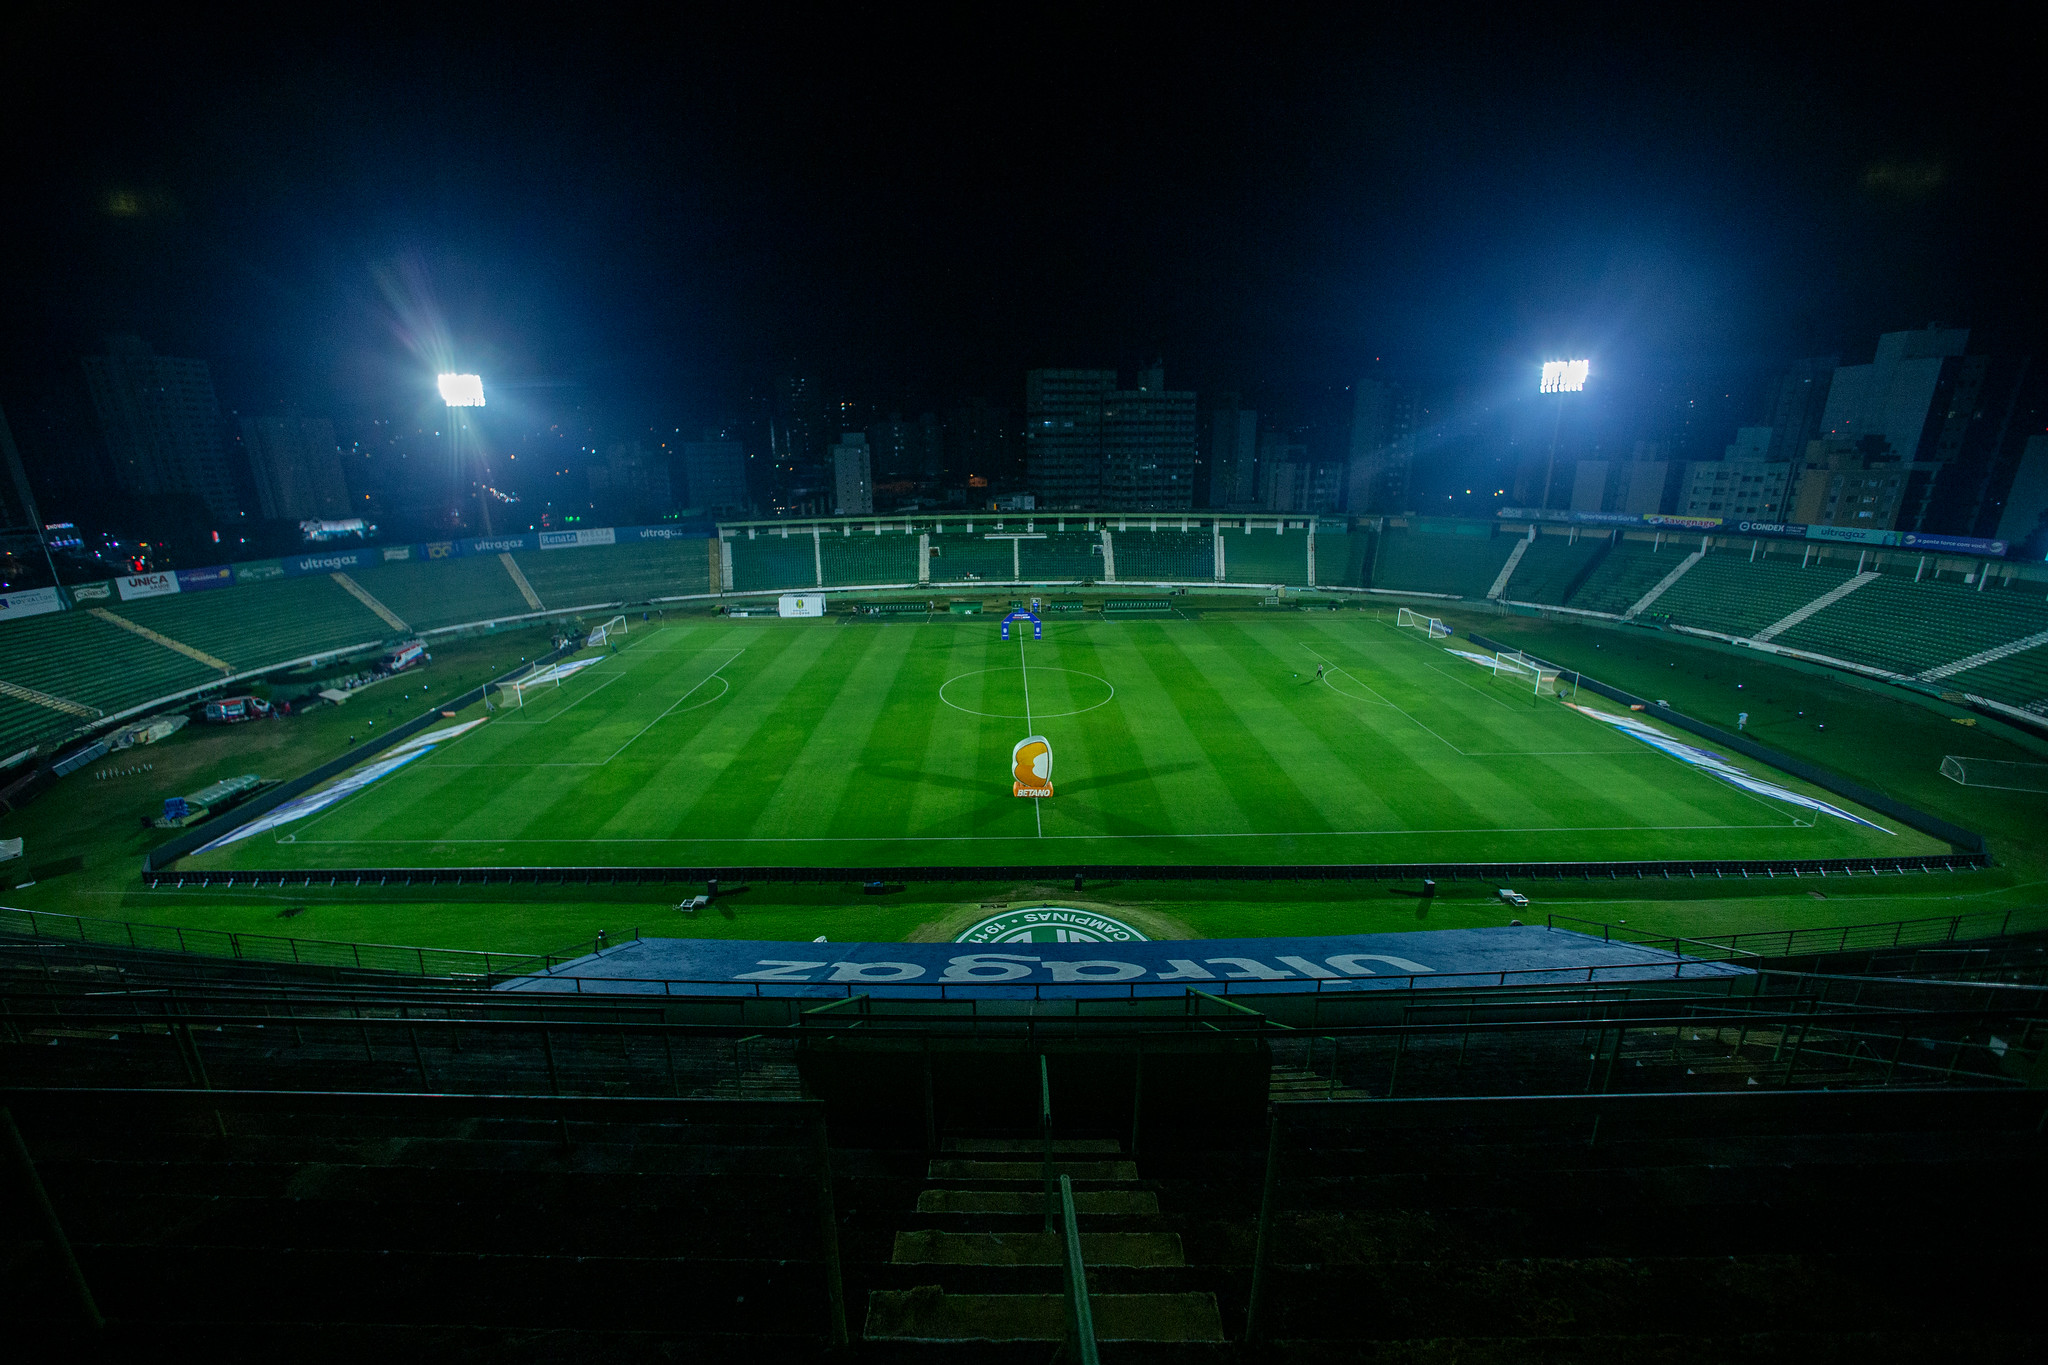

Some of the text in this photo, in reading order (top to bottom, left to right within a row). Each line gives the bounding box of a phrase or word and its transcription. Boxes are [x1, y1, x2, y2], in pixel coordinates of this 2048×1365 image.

[1664, 517, 1716, 529] Savegnago
[1751, 522, 1785, 533] CONDEX
[542, 532, 577, 544] Renata
[640, 528, 683, 539] ultragaz
[1821, 529, 1867, 539] ultragaz
[474, 539, 524, 551] ultragaz
[300, 555, 358, 571] ultragaz
[1017, 789, 1050, 797] BETANO
[1023, 912, 1131, 941] CAMPINAS
[732, 953, 1437, 985] ultragaz
